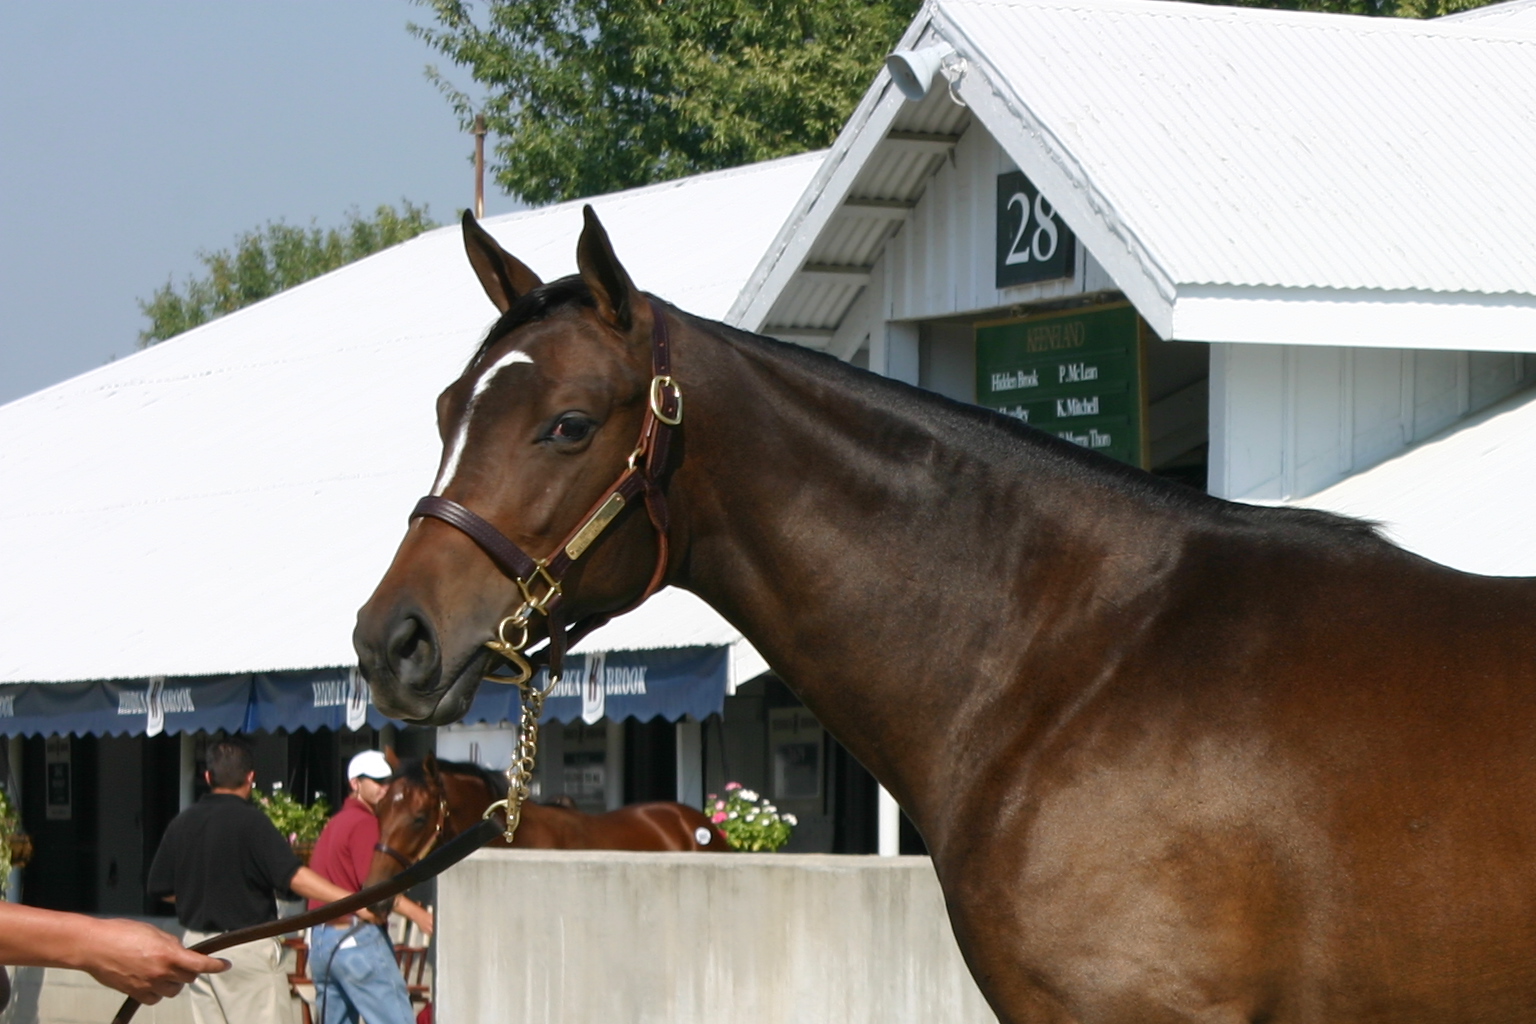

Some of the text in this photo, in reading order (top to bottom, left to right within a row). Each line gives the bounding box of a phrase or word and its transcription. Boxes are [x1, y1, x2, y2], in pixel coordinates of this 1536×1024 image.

[1005, 192, 1058, 265] 28
[991, 369, 1039, 392] Hidden Brook
[606, 666, 648, 695] BROOK
[162, 687, 195, 713] BROOK
